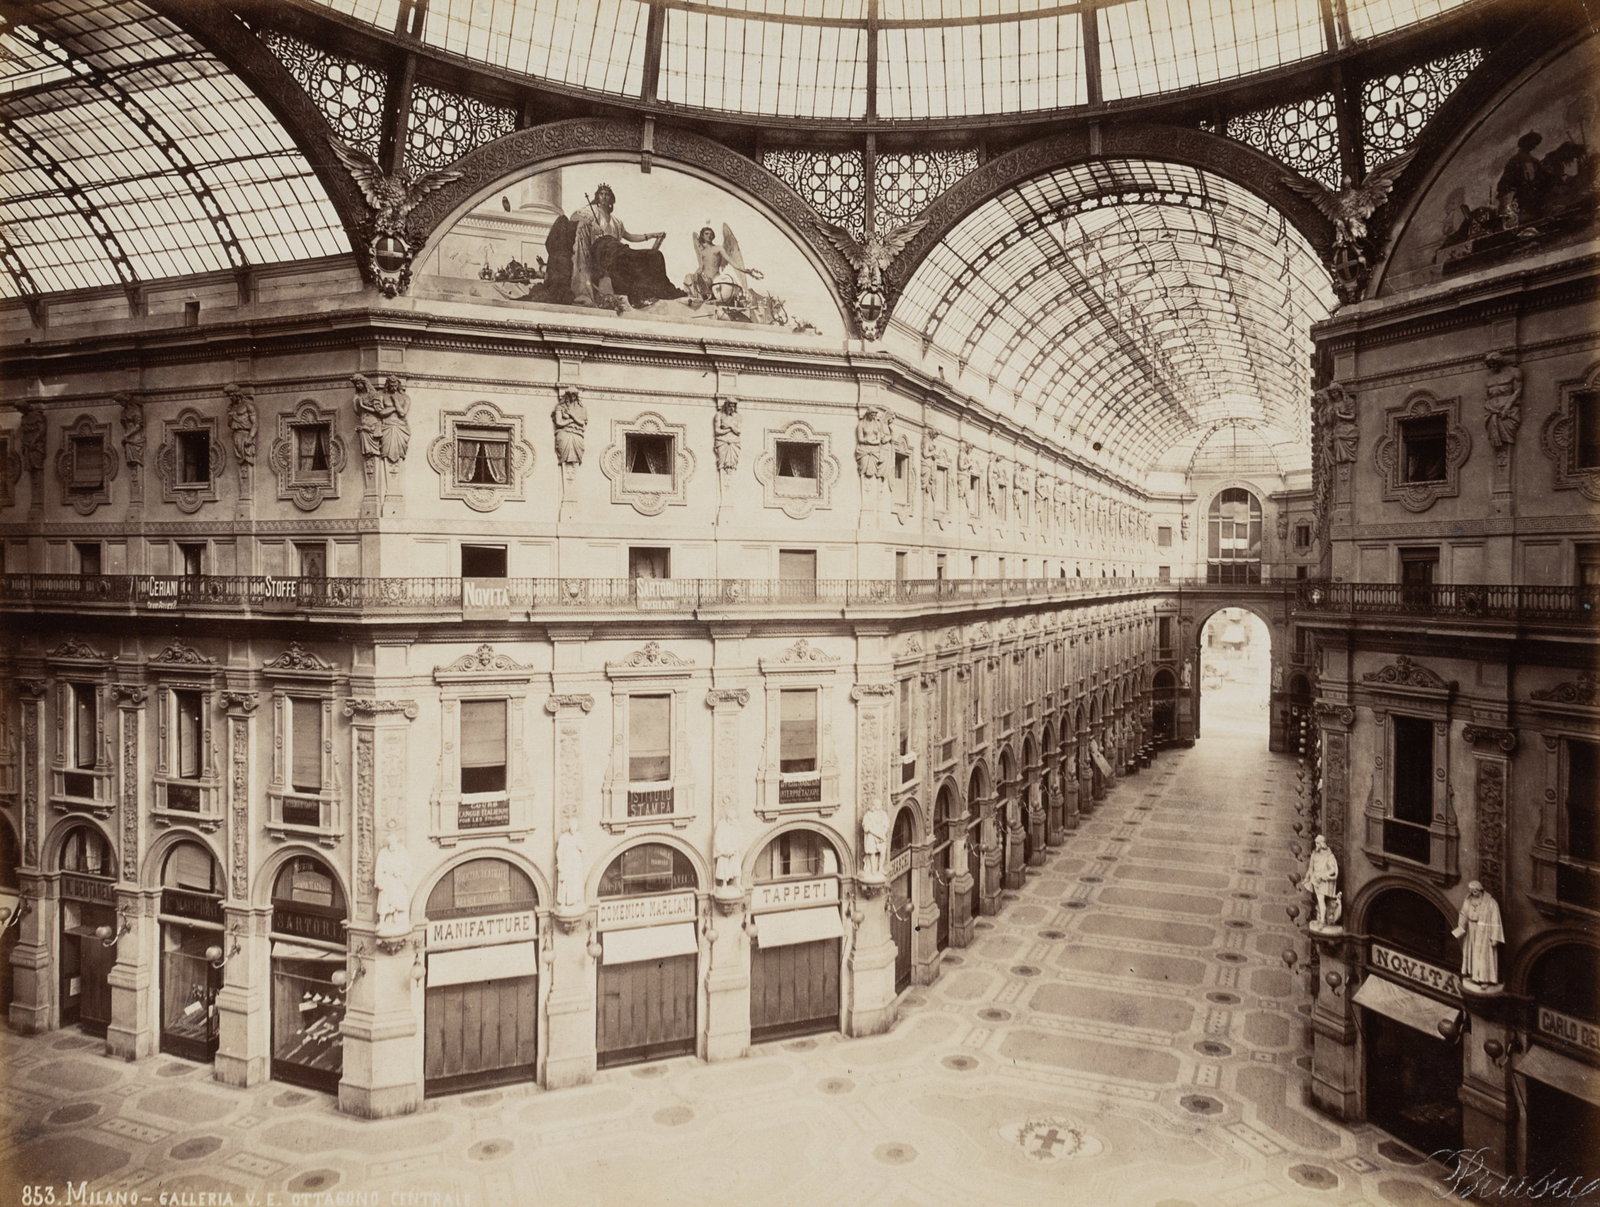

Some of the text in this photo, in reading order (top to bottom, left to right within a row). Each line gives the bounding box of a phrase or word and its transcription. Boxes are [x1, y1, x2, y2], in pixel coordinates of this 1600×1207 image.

[150, 576, 178, 597] CERIANI
[265, 575, 296, 597] STOFFE
[631, 802, 671, 816] STAMPA
[763, 883, 827, 904] TAPPETI
[601, 902, 645, 922] DOMENICO
[433, 915, 530, 942] MANIFATTURE
[1542, 1011, 1578, 1041] CARLO
